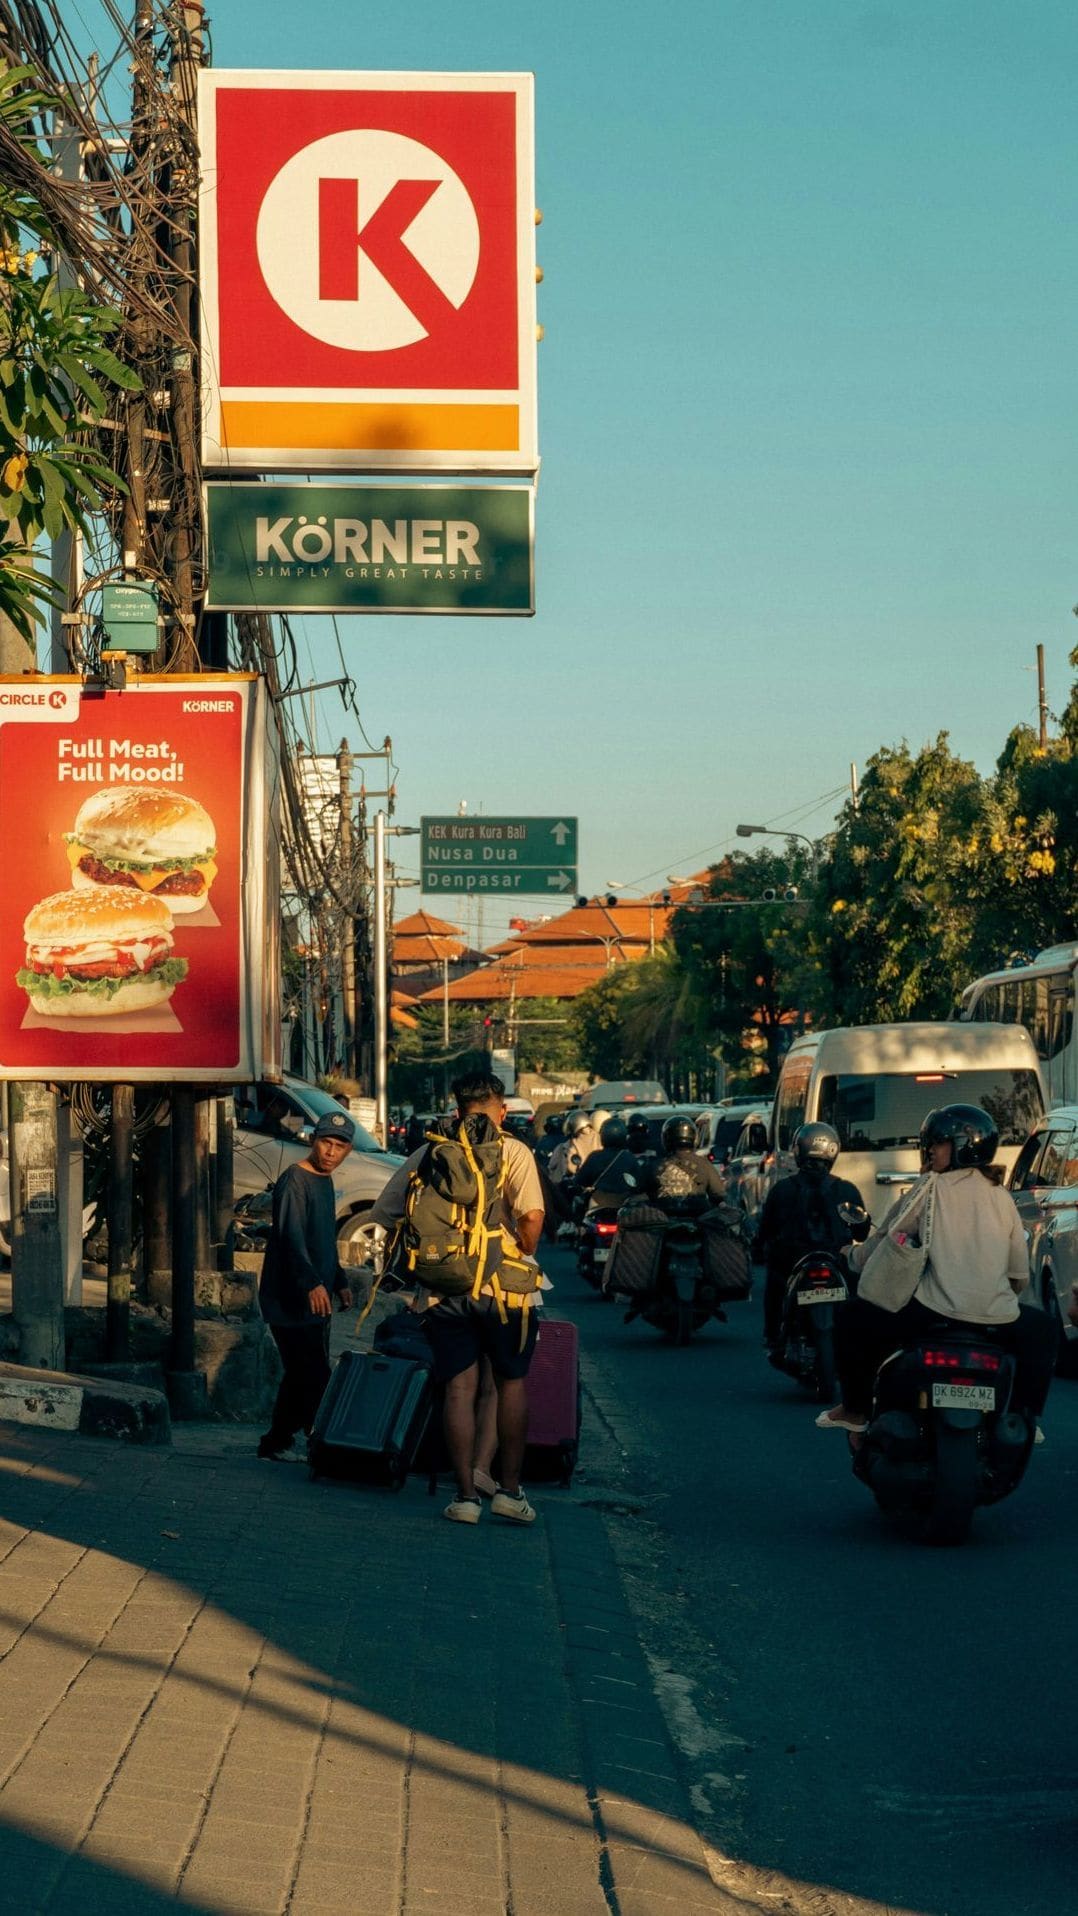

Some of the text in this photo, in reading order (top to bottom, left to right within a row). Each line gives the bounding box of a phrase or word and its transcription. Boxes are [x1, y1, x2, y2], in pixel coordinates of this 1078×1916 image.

[319, 178, 459, 336] K
[256, 516, 482, 565] KÖRNER
[256, 566, 482, 580] SIMPLY GREAT TASTE
[0, 694, 46, 706] CIRCLE
[182, 701, 235, 713] KÖRNER
[58, 739, 178, 761] Full Meat,
[58, 762, 185, 782] Full Mood!
[428, 824, 526, 839] KEK Kura Kura Bali
[428, 847, 518, 861] Nusa Dua
[428, 873, 522, 890] Denpasar
[934, 1385, 993, 1400] DK 6924 MZ
